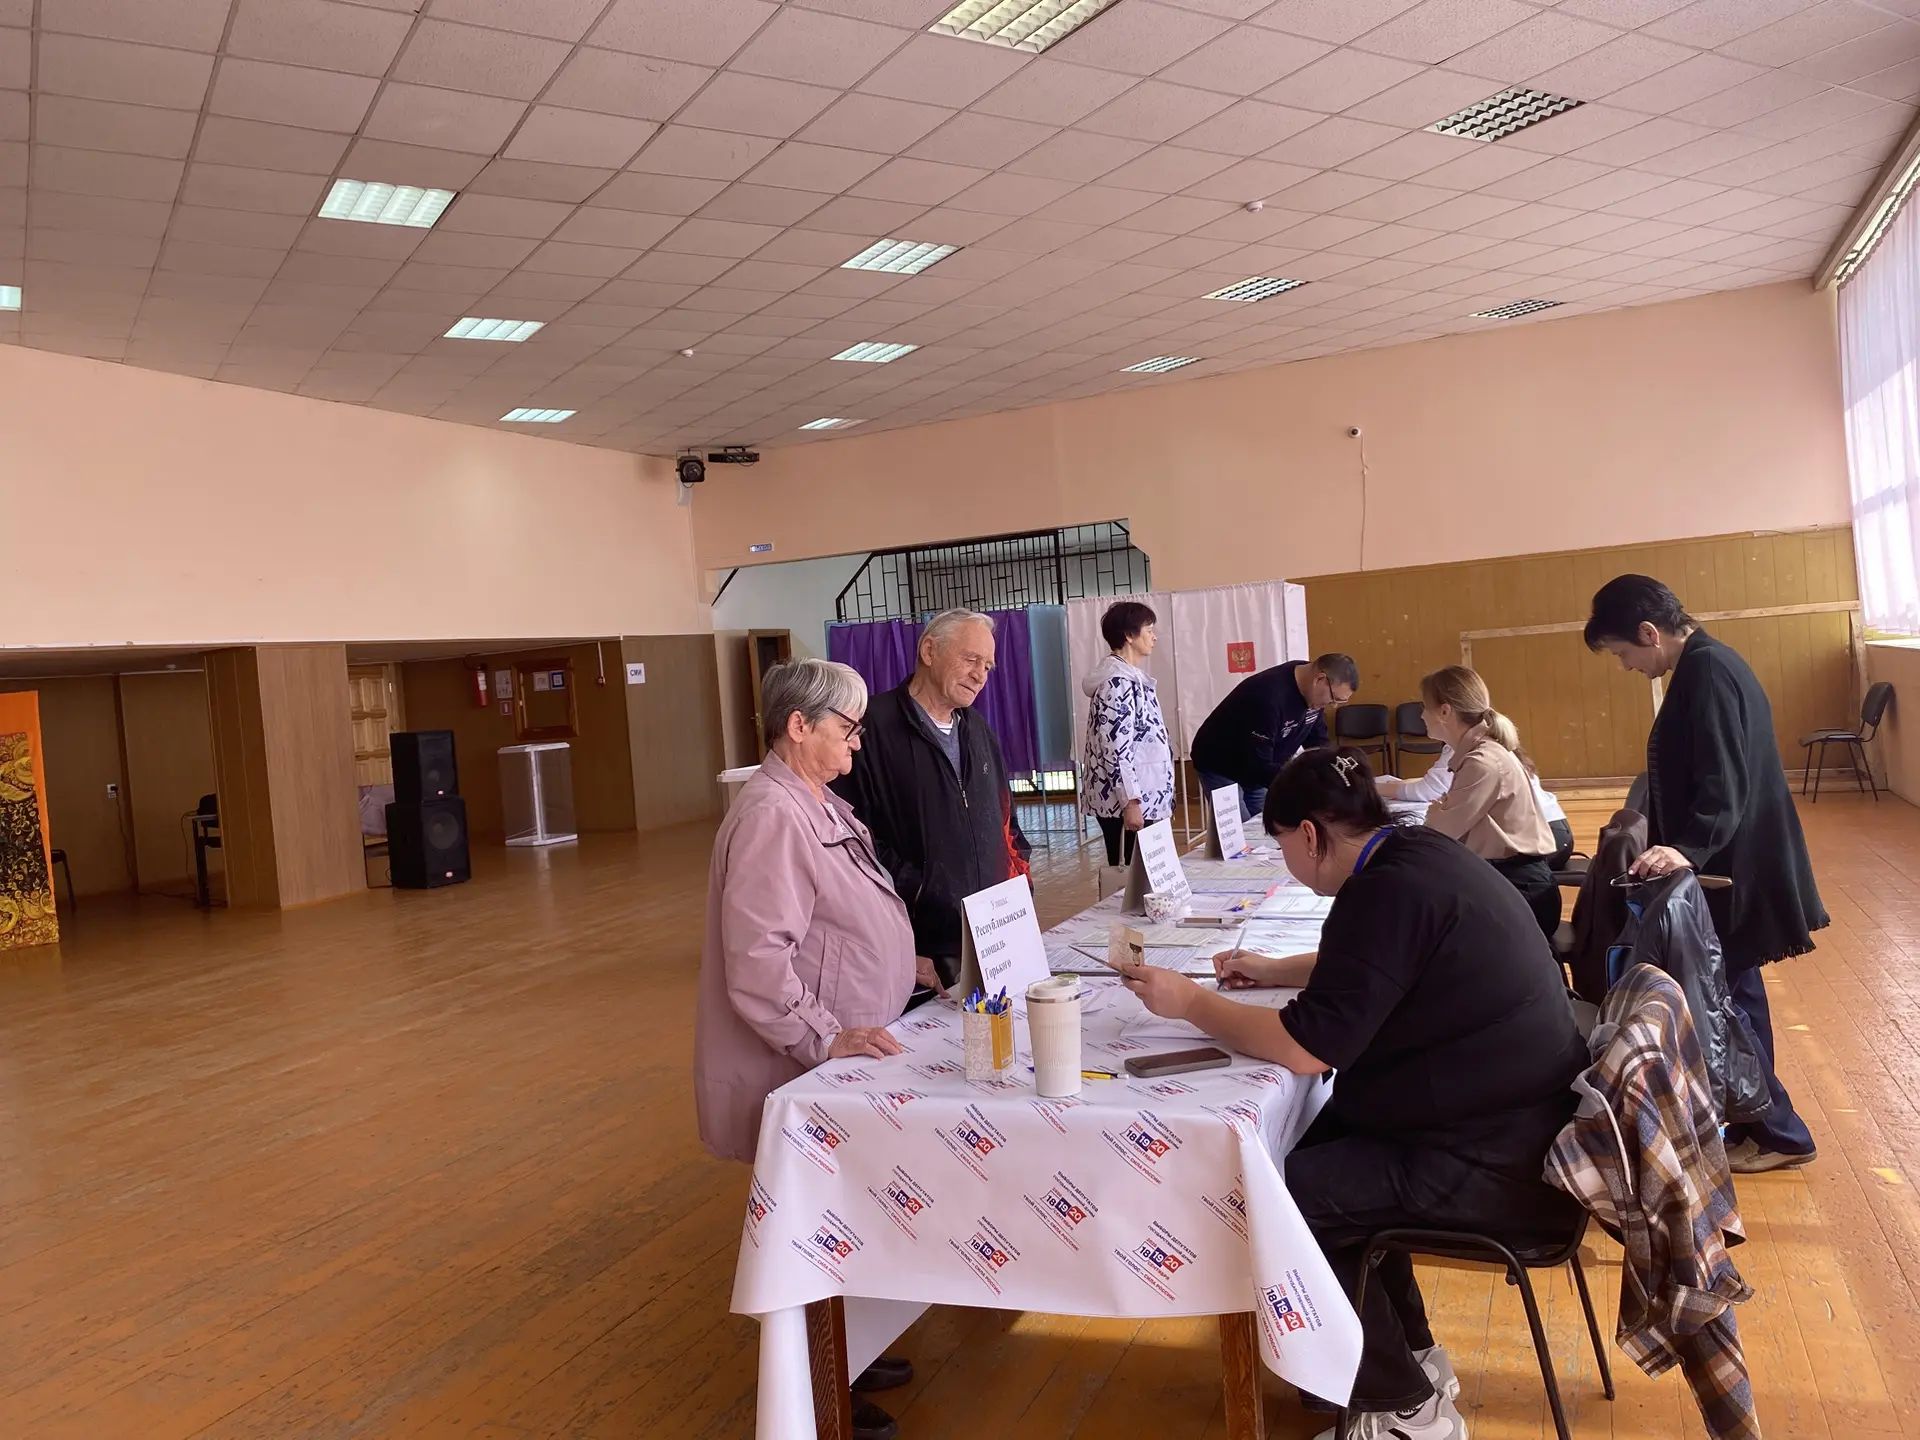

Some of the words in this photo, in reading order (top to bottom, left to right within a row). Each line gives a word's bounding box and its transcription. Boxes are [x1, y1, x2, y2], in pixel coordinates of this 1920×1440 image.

[975, 907, 1026, 938] Республиканская
[981, 940, 1006, 959] площадь
[985, 959, 1011, 980] Горького
[955, 1127, 967, 1139] 18
[967, 1133, 978, 1144] 19
[978, 1139, 991, 1152] 20
[1126, 1130, 1138, 1141] 18
[1138, 1135, 1150, 1147] 19
[1151, 1141, 1165, 1155] 20
[886, 1187, 897, 1198] 18
[897, 1193, 907, 1203] 19
[908, 1200, 919, 1211] 20
[1023, 1195, 1034, 1206] ТВОЙ
[1045, 1195, 1057, 1206] 18
[1057, 1201, 1068, 1212] 19
[1069, 1208, 1083, 1221] 20
[1202, 1196, 1214, 1207] ТВОЙ
[1227, 1196, 1238, 1206] 18
[756, 1206, 763, 1217] 20
[814, 1234, 824, 1244] 18
[825, 1238, 836, 1248] 19
[837, 1243, 849, 1255] 20
[949, 1239, 960, 1250] ТВОЙ
[970, 1239, 981, 1250] 18
[982, 1245, 992, 1256] 19
[993, 1252, 1005, 1264] 20
[1171, 1237, 1197, 1259] ДЕПУТАТОВ
[1114, 1249, 1126, 1260] ТВОЙ
[1125, 1259, 1141, 1273] ГОЛОС
[1144, 1274, 1156, 1285] СИЛА
[1139, 1247, 1151, 1258] 18
[1152, 1251, 1164, 1263] 19
[1164, 1257, 1179, 1270] 20
[1147, 1261, 1170, 1280] СЕНТЯБРЯ
[1266, 1289, 1277, 1302] 18
[1276, 1301, 1288, 1314] 19
[1286, 1312, 1300, 1329] 20
[1304, 1294, 1322, 1327] ДЕПУТАТОВ
[1268, 1306, 1284, 1336] СЕНТЯБРЯ
